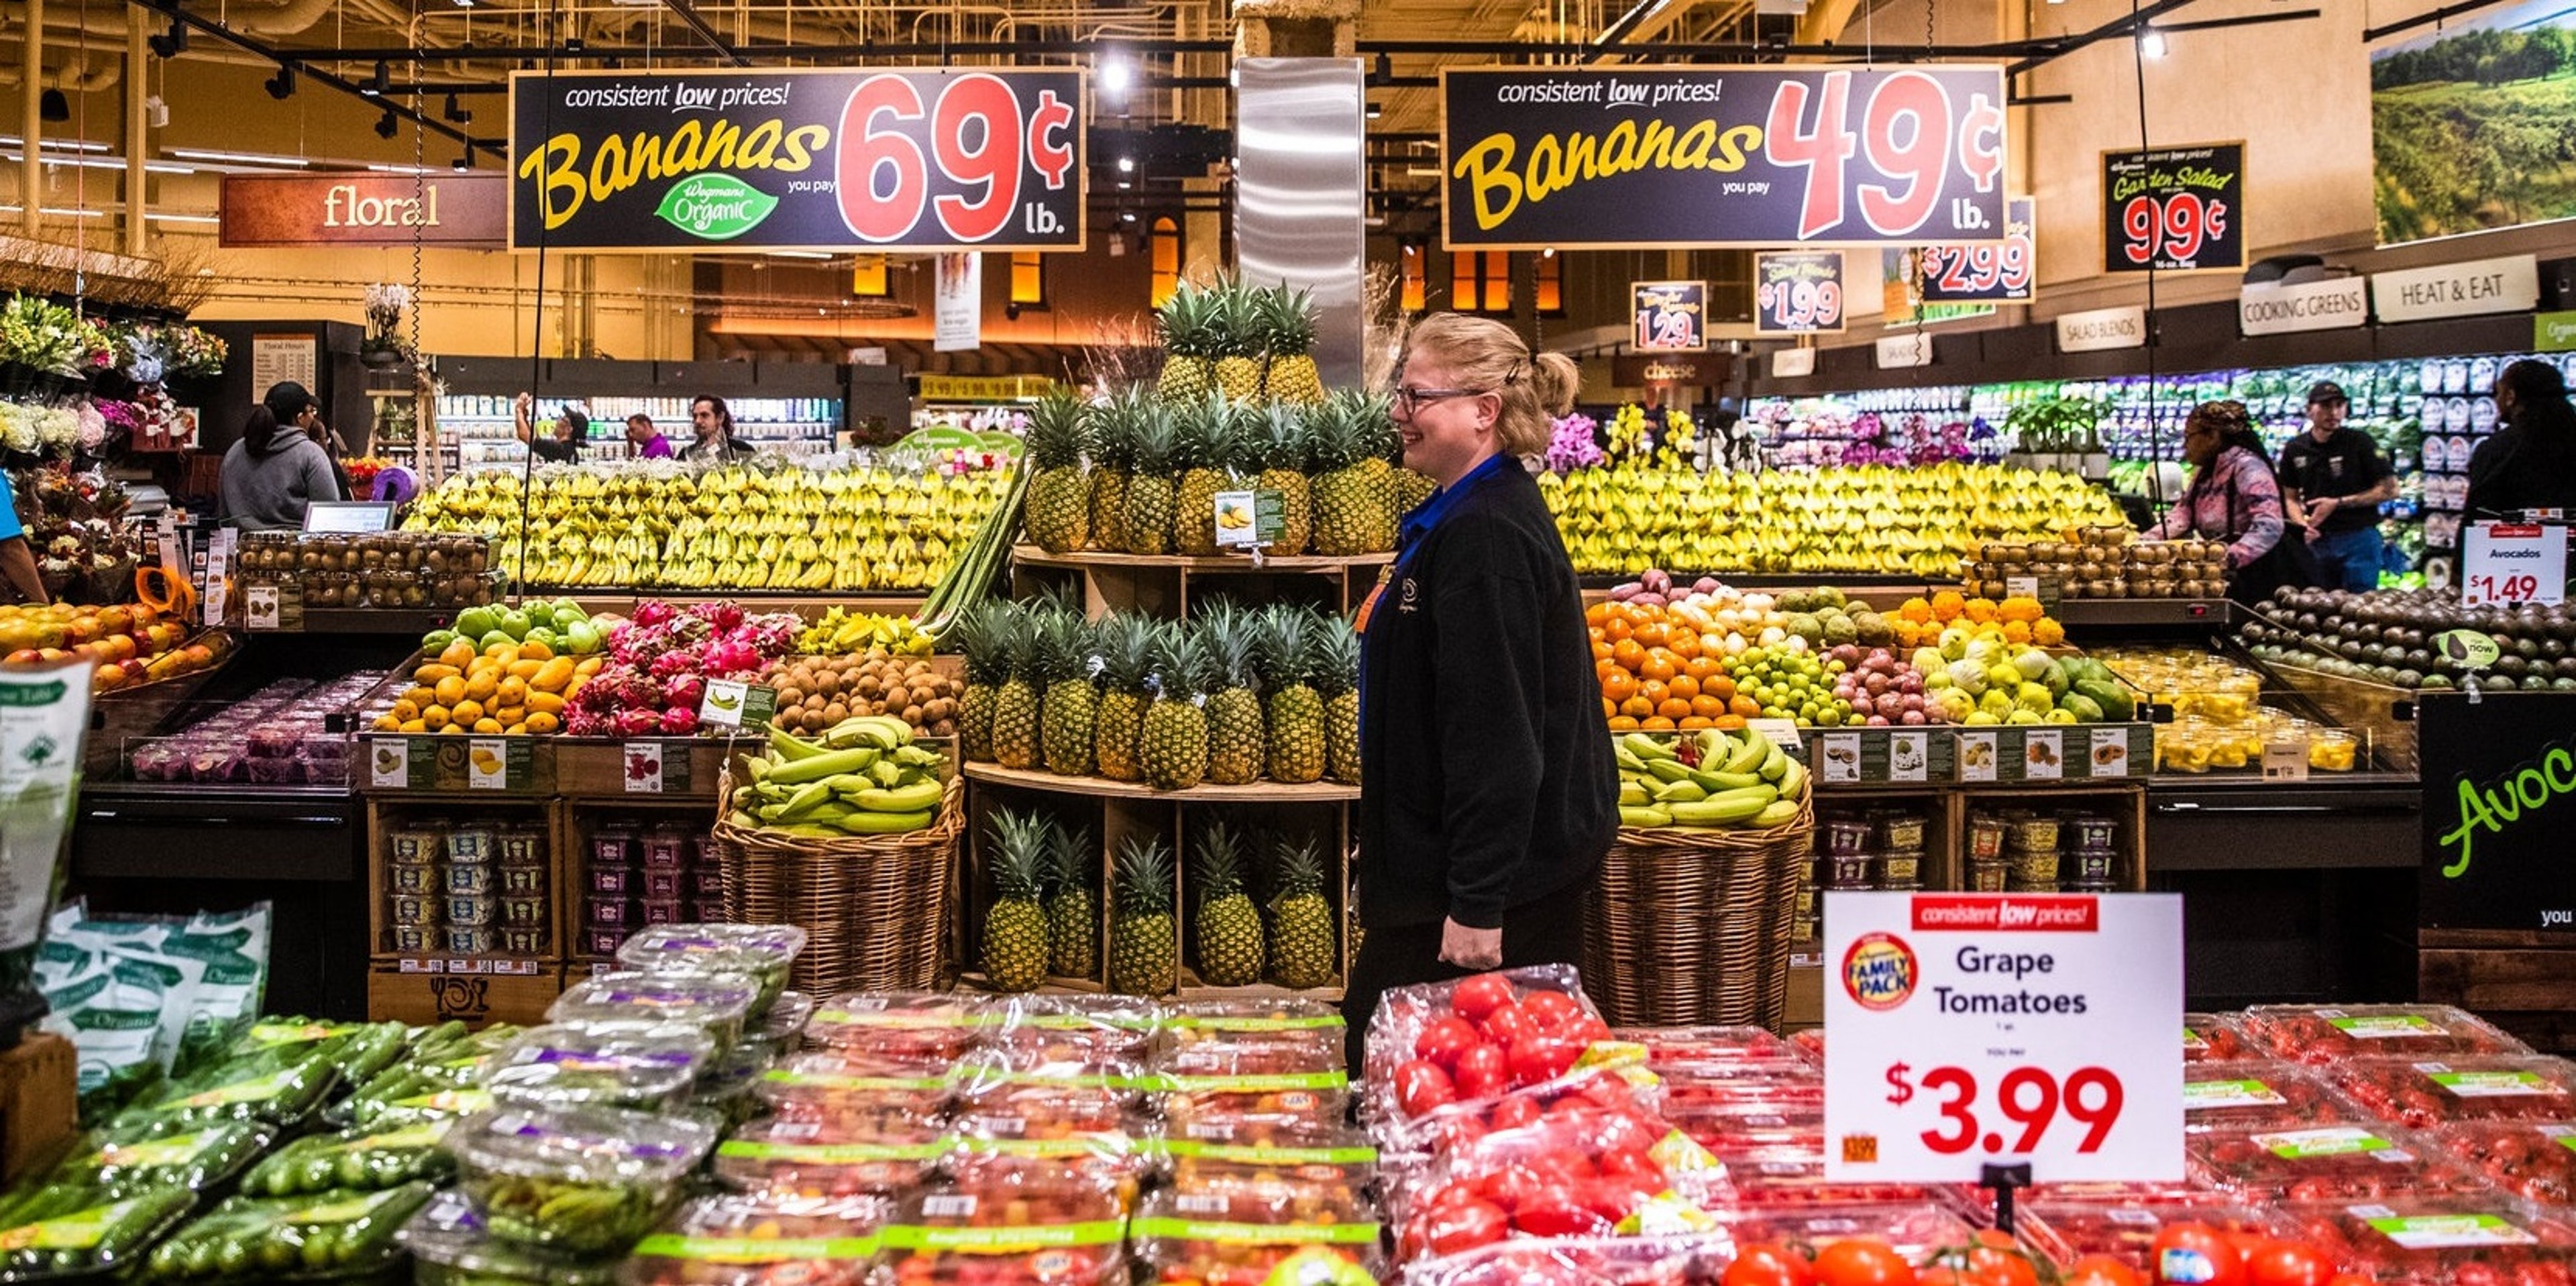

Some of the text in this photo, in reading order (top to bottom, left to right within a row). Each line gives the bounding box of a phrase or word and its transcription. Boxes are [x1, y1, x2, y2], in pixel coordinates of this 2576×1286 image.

[566, 82, 790, 111] consistent low prices!
[1497, 78, 1721, 107] consistent low prices!
[519, 119, 830, 231] Bananas
[788, 180, 836, 195] you pay
[1453, 119, 1763, 231] Bananas
[1723, 181, 1770, 195] you pay
[2174, 166, 2233, 190] Salad
[683, 180, 746, 203] Wegmans
[324, 185, 440, 227] floral
[1025, 203, 1065, 235] lb.
[1952, 198, 1990, 229] lb.
[2402, 274, 2504, 306] HEAT & EAT
[2245, 292, 2360, 323] COOKING GREENS
[2067, 318, 2135, 341] SALAD BLENDS
[1645, 360, 1695, 379] cheese
[2489, 549, 2540, 558] Avocados
[2470, 575, 2538, 600] $1.49
[2469, 645, 2493, 653] now
[1921, 899, 2088, 928] consistent low prices!
[2541, 910, 2572, 927] you
[1849, 957, 1908, 980] FAMILY
[1957, 945, 2054, 980] Grape
[1859, 973, 1908, 998] PACK
[1933, 986, 2088, 1014] Tomatoes
[1886, 1060, 2124, 1154] $3.99
